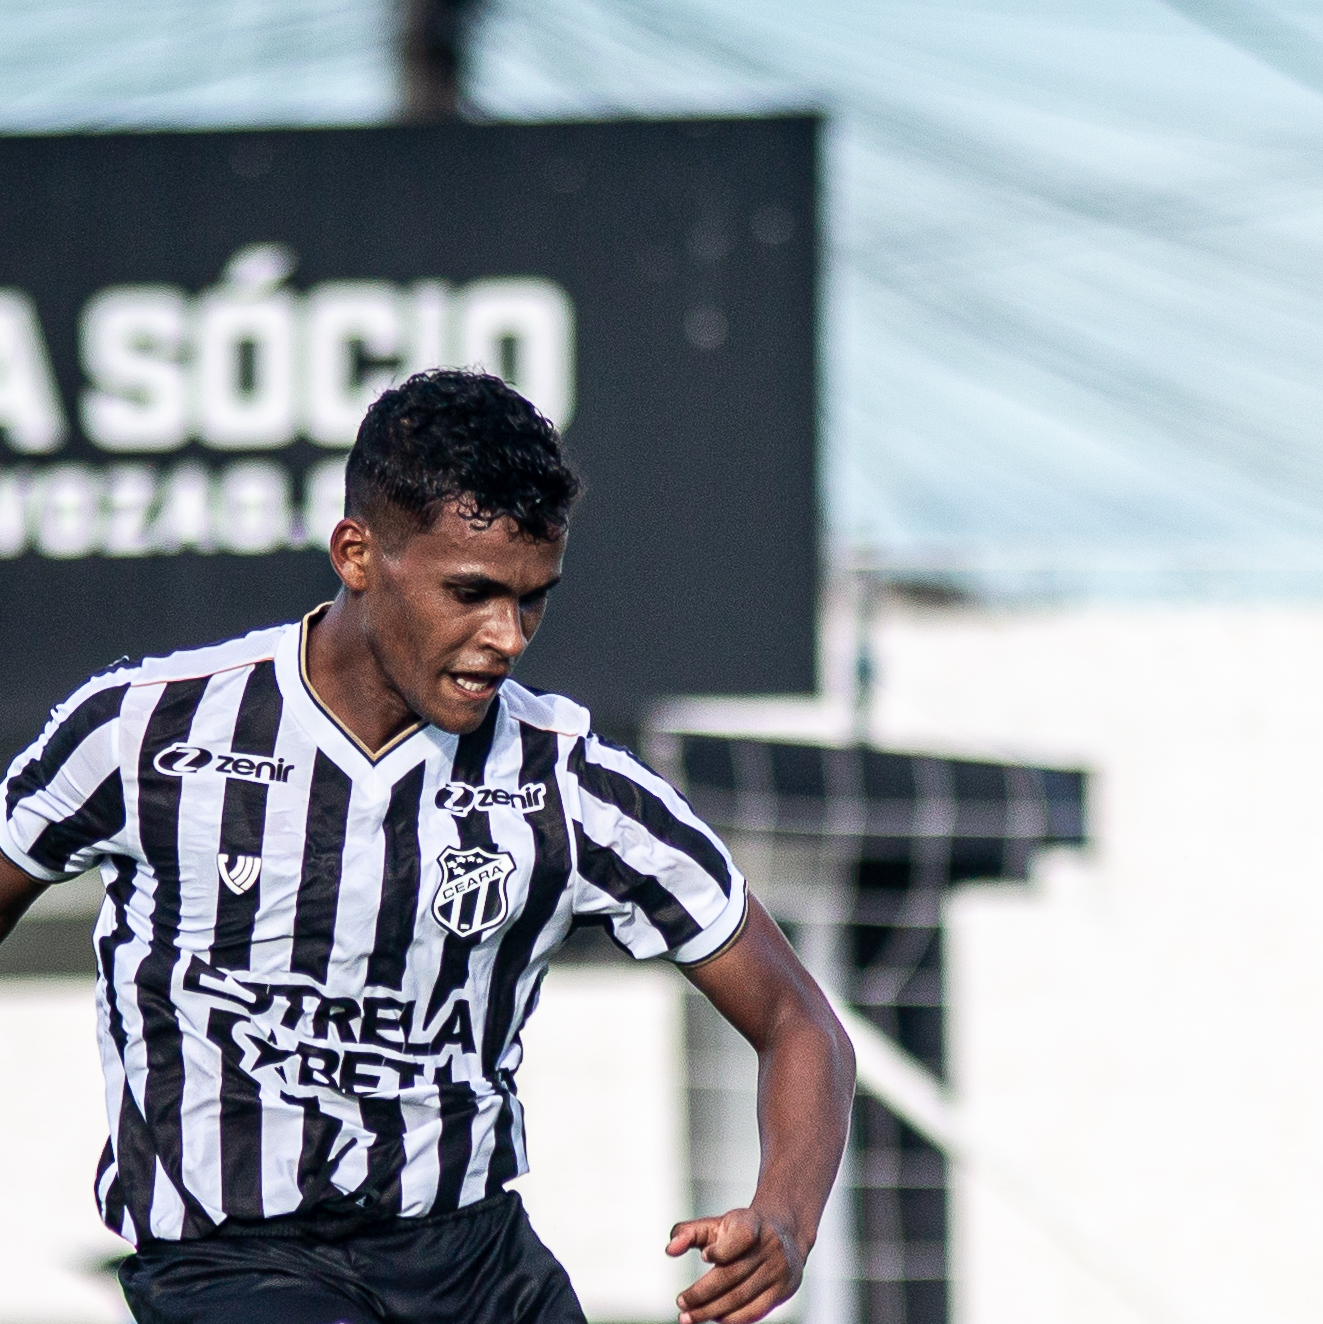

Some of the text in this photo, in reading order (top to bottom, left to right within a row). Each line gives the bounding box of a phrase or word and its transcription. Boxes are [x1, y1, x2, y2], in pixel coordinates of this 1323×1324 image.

[78, 243, 576, 452] SÓCIO
[216, 754, 295, 783] zenir
[477, 786, 543, 810] zenir
